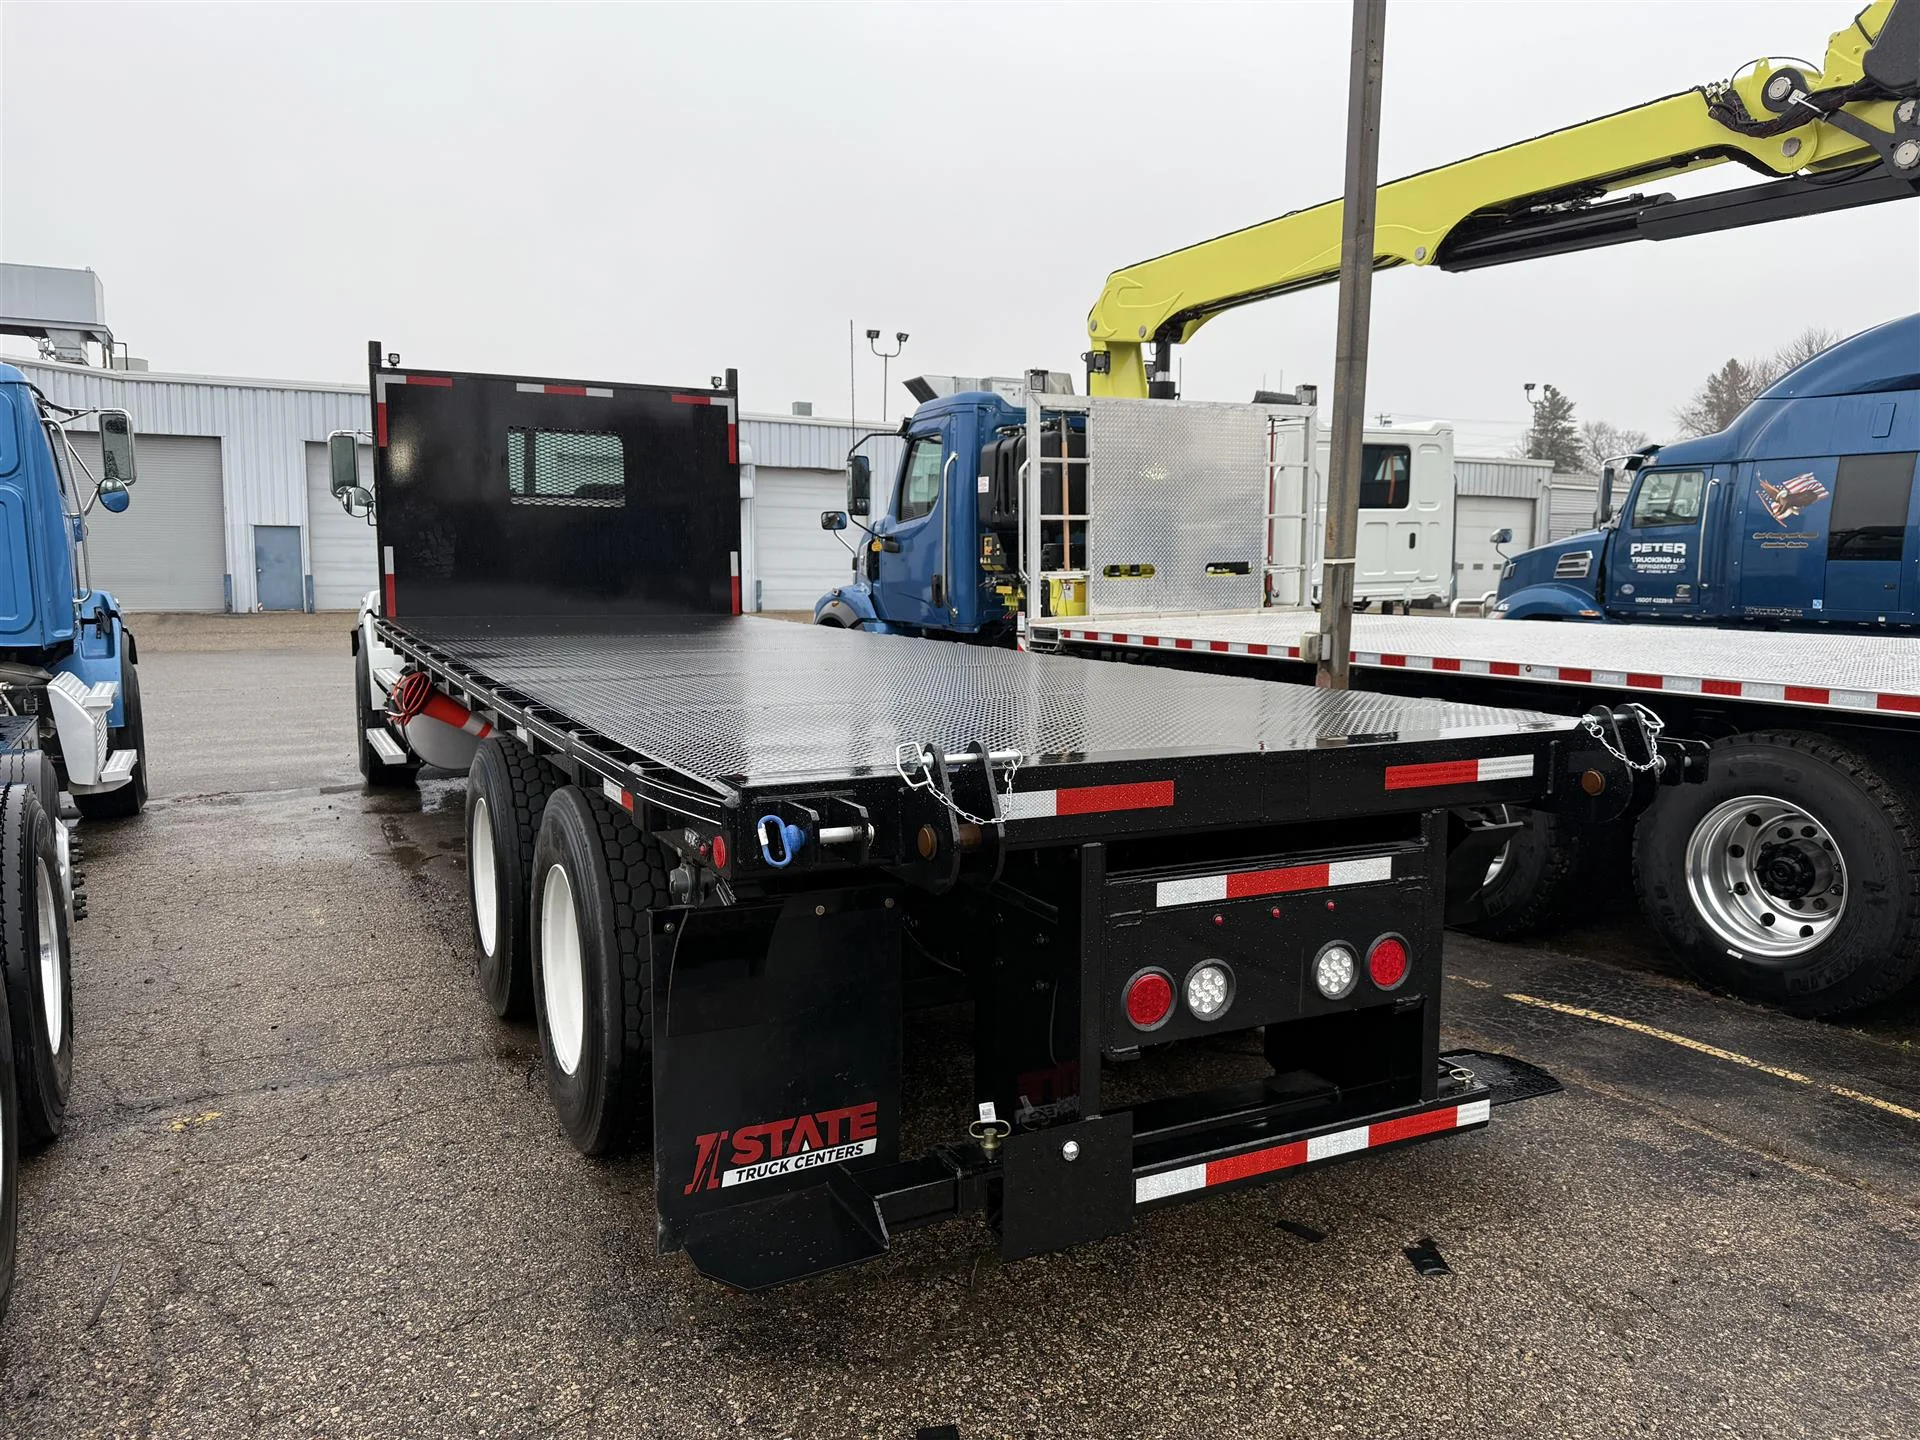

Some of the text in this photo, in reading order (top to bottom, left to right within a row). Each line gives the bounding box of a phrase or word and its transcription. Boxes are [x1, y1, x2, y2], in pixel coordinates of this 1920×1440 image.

[1630, 543, 1686, 555] PETER
[730, 1101, 878, 1165] STATE
[735, 1143, 864, 1183] TRUCK CENTERS
